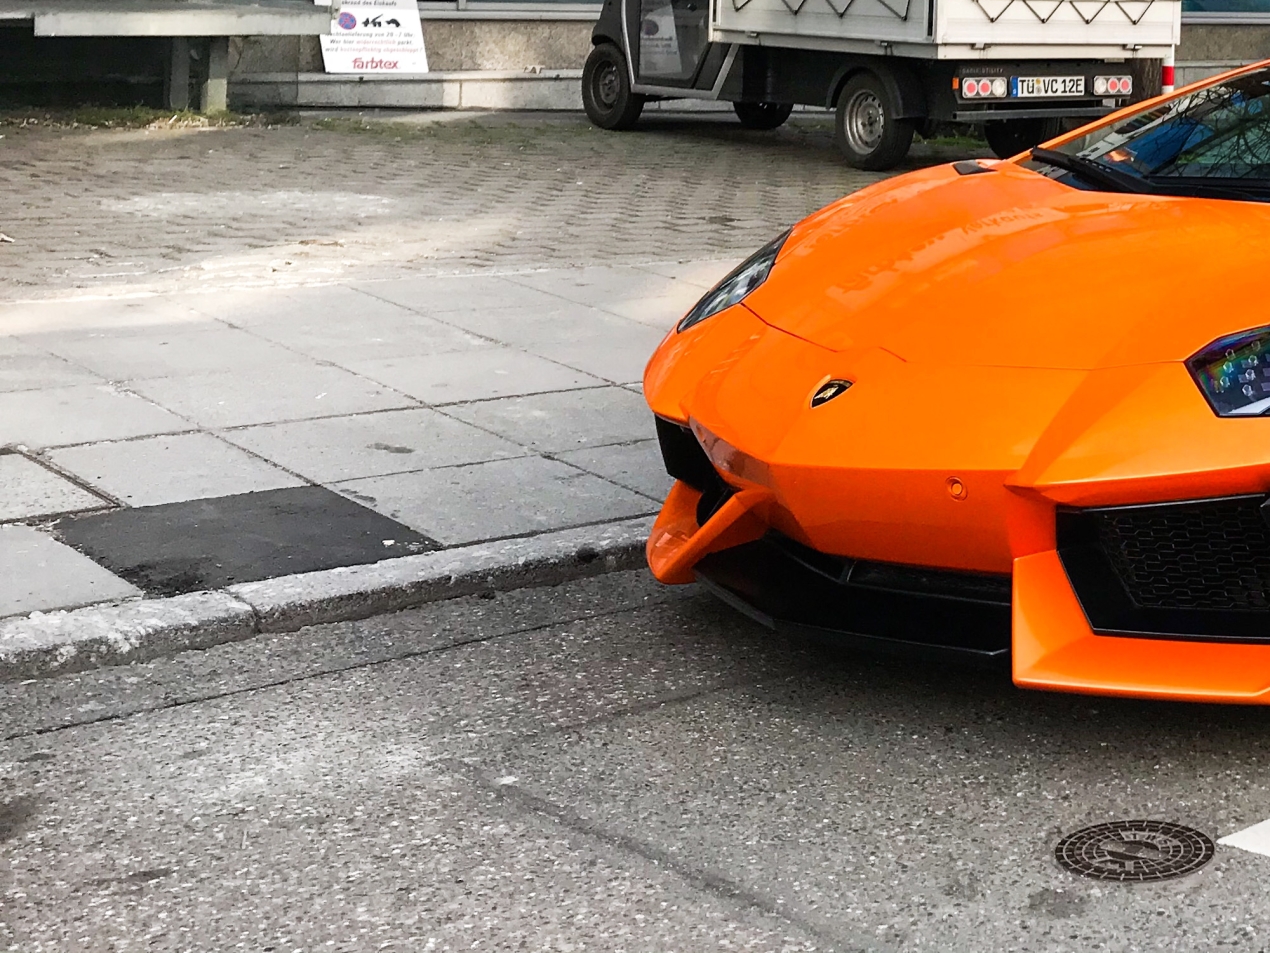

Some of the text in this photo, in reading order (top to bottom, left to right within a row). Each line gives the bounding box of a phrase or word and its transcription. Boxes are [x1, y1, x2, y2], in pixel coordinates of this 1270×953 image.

[352, 57, 398, 70] farbtex
[1019, 79, 1083, 94] TÜ VC 12E
